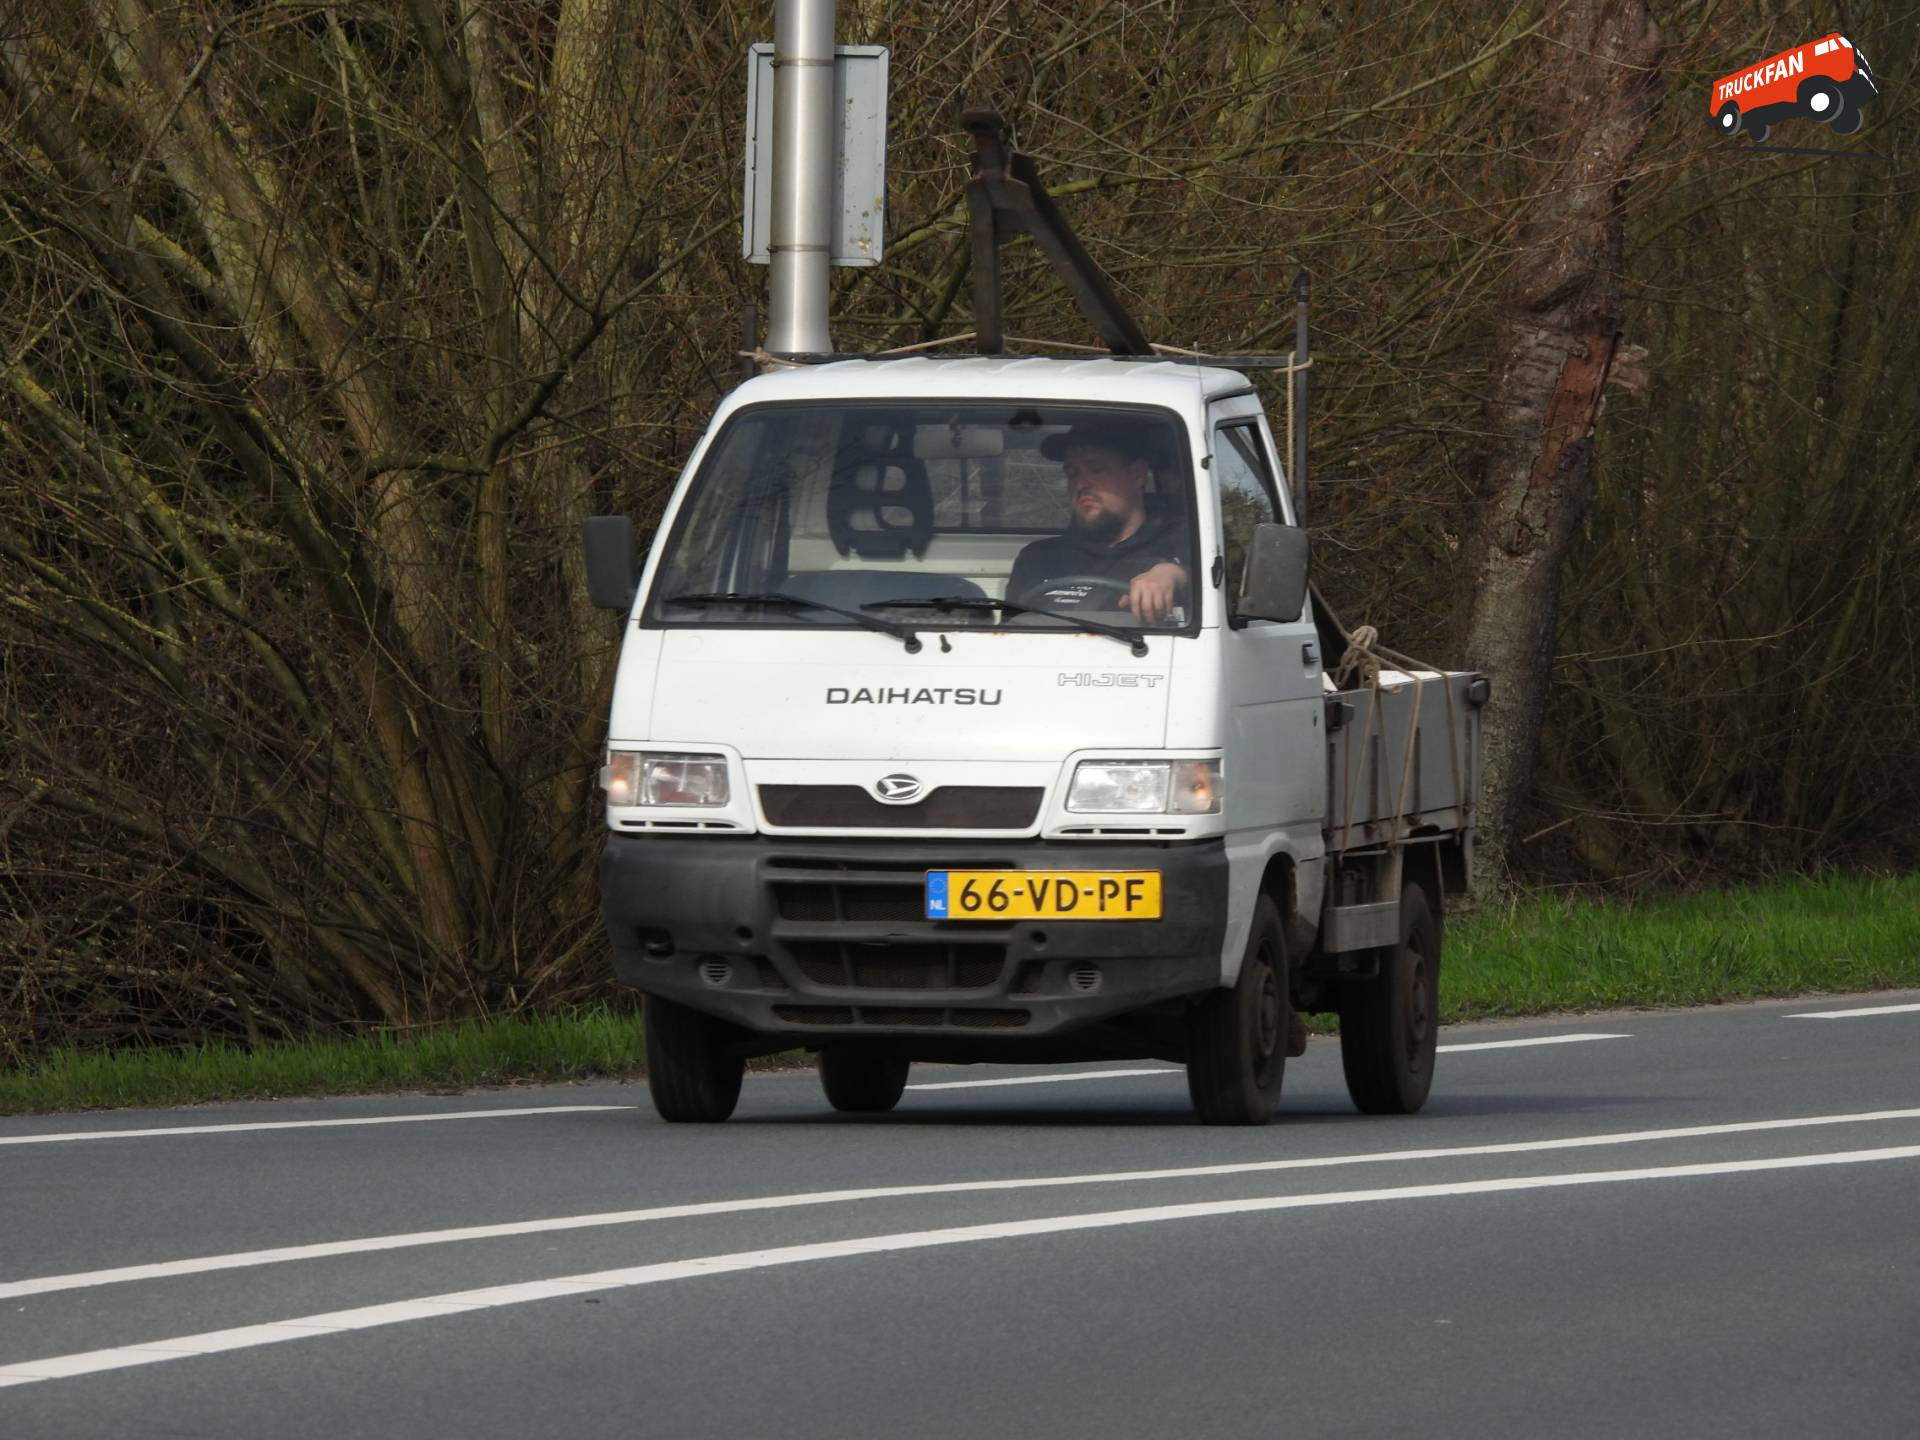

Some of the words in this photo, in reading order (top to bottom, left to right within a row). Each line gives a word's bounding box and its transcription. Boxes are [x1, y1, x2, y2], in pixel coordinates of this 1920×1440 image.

[1057, 673, 1164, 687] HIJET
[826, 687, 1002, 706] DAIHATSU
[960, 878, 1145, 912] 66-VD-PF
[929, 899, 946, 911] NL
